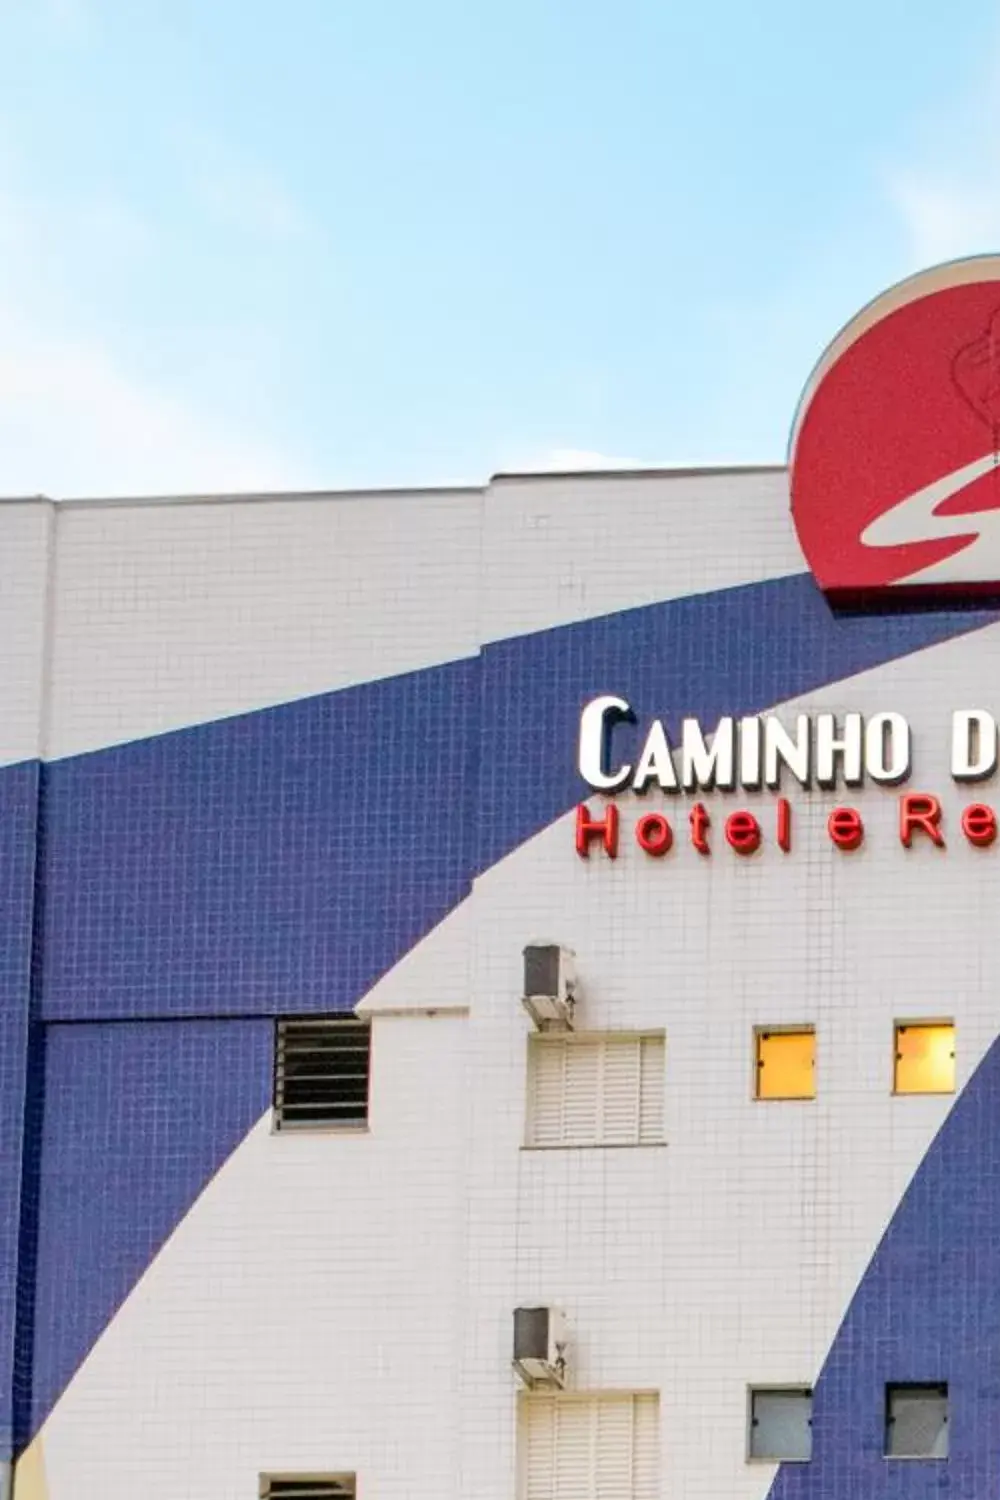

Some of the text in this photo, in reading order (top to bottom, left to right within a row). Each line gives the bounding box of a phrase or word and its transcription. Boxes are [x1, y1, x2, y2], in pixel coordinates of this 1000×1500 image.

[578, 695, 912, 793] CAMINHO
[575, 795, 791, 861] Hotel
[827, 806, 864, 850] e
